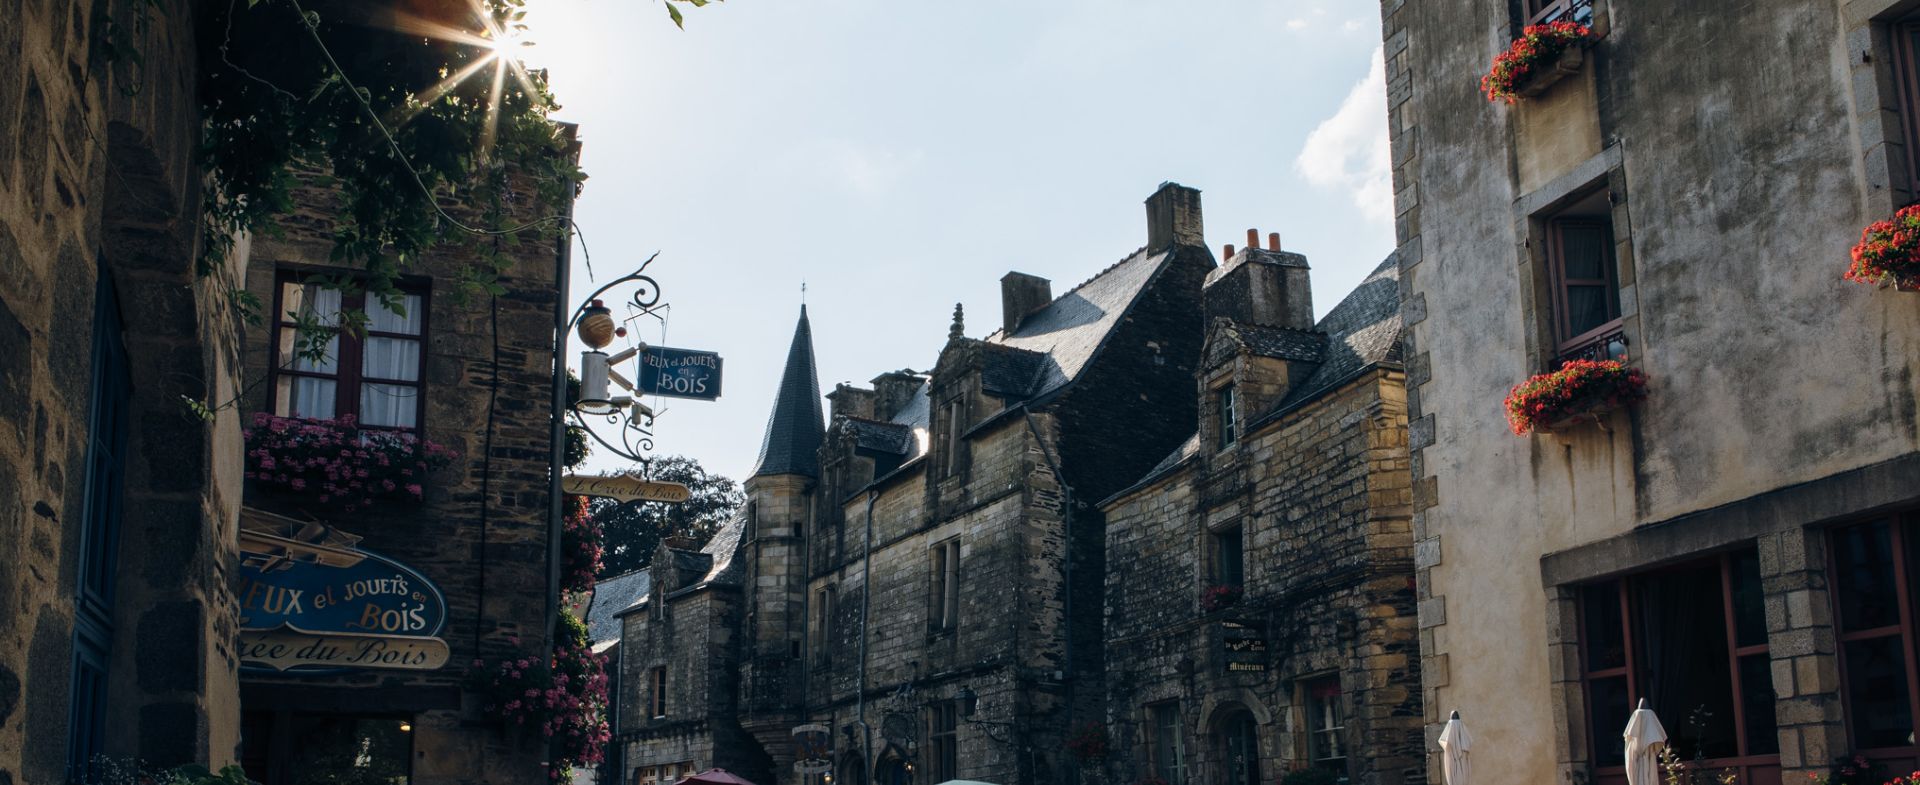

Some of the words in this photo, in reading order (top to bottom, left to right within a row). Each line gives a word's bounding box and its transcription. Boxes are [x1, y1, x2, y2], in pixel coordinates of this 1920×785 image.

[644, 353, 669, 368] JEUX
[671, 358, 679, 367] et
[680, 355, 716, 369] JOUETS
[678, 368, 689, 376] en
[629, 485, 646, 497] du
[649, 486, 682, 500] Bois
[313, 585, 337, 609] et
[344, 575, 408, 600] JOUETS
[412, 591, 427, 603] en
[296, 639, 343, 661] du
[347, 640, 426, 666] Bois
